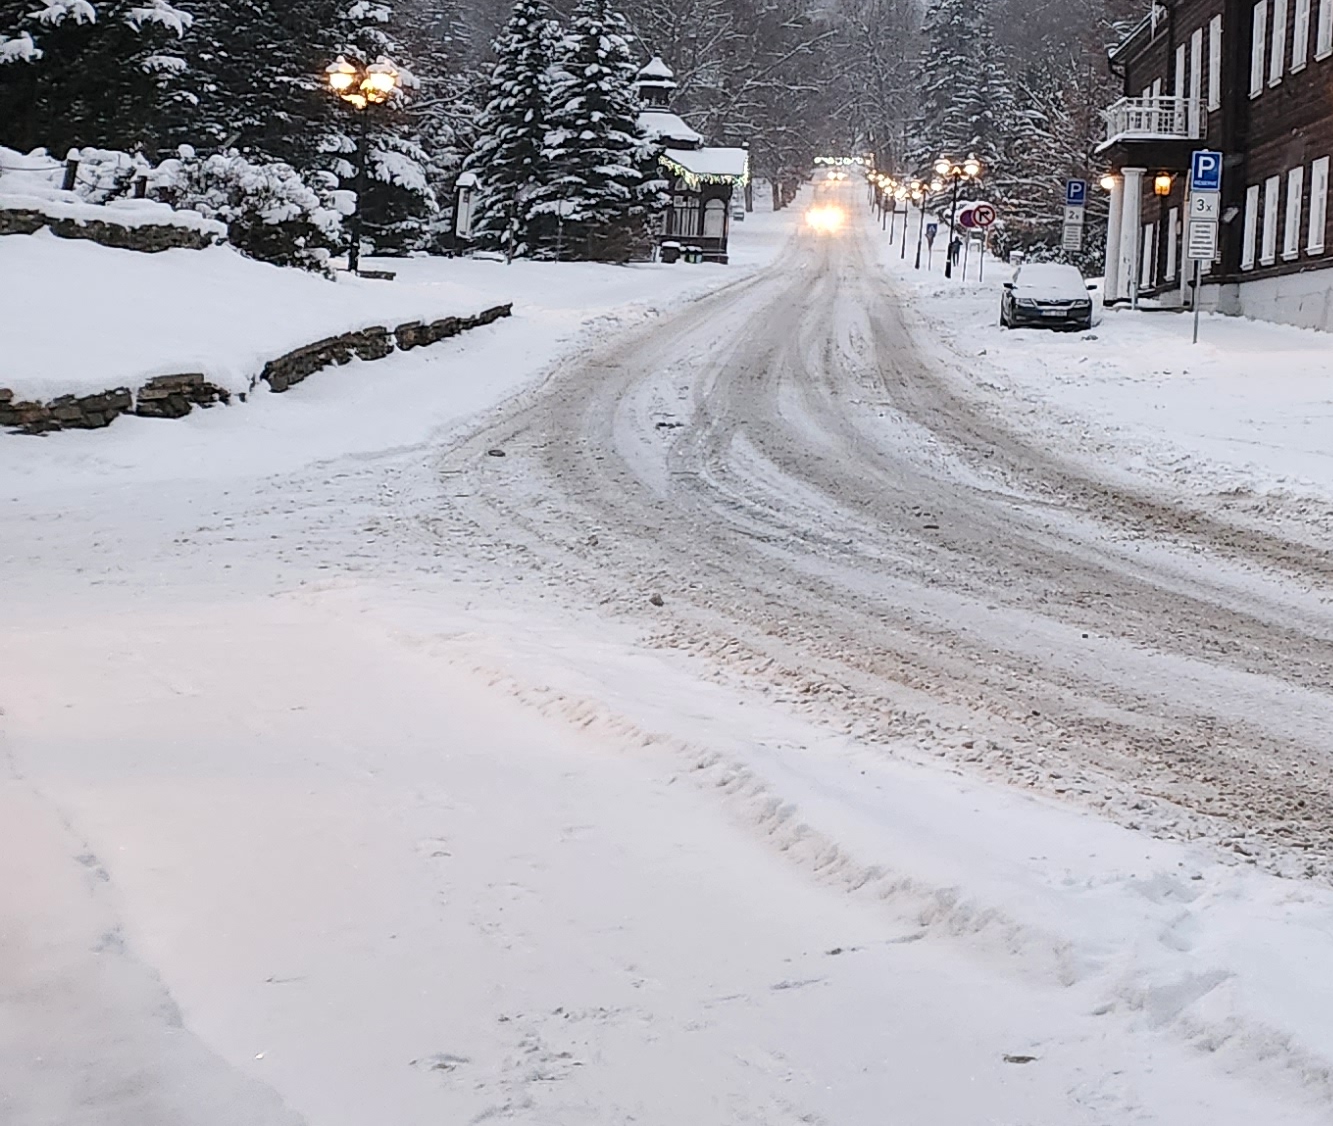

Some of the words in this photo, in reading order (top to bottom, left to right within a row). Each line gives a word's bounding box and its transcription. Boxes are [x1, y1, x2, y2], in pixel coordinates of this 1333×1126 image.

[1197, 155, 1216, 179] P
[1070, 183, 1082, 198] P
[1196, 198, 1212, 212] 3x
